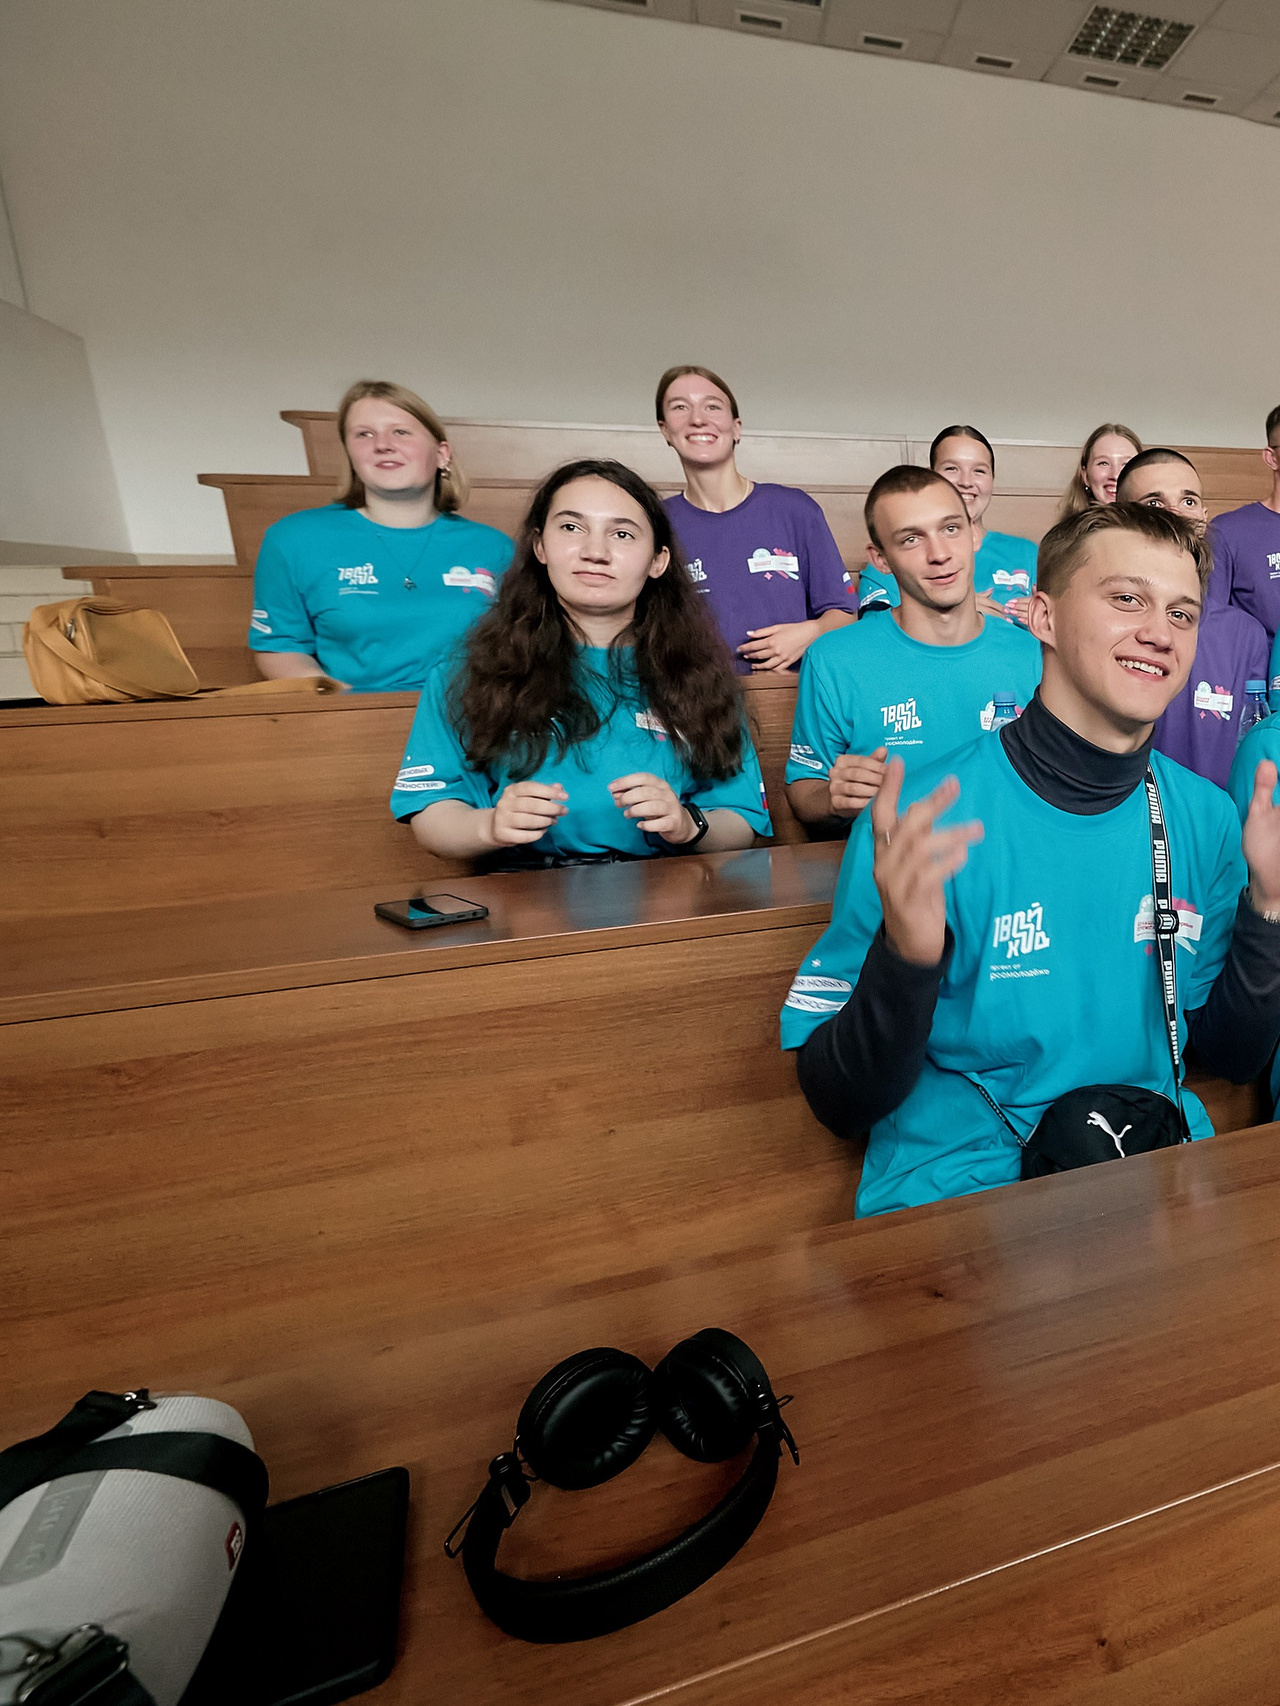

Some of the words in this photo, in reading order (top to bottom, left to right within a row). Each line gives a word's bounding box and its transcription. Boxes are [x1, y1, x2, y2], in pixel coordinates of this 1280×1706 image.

[1146, 782, 1163, 824] PUMA
[1153, 839, 1168, 883] PUMA
[1163, 960, 1175, 1005] PUMA
